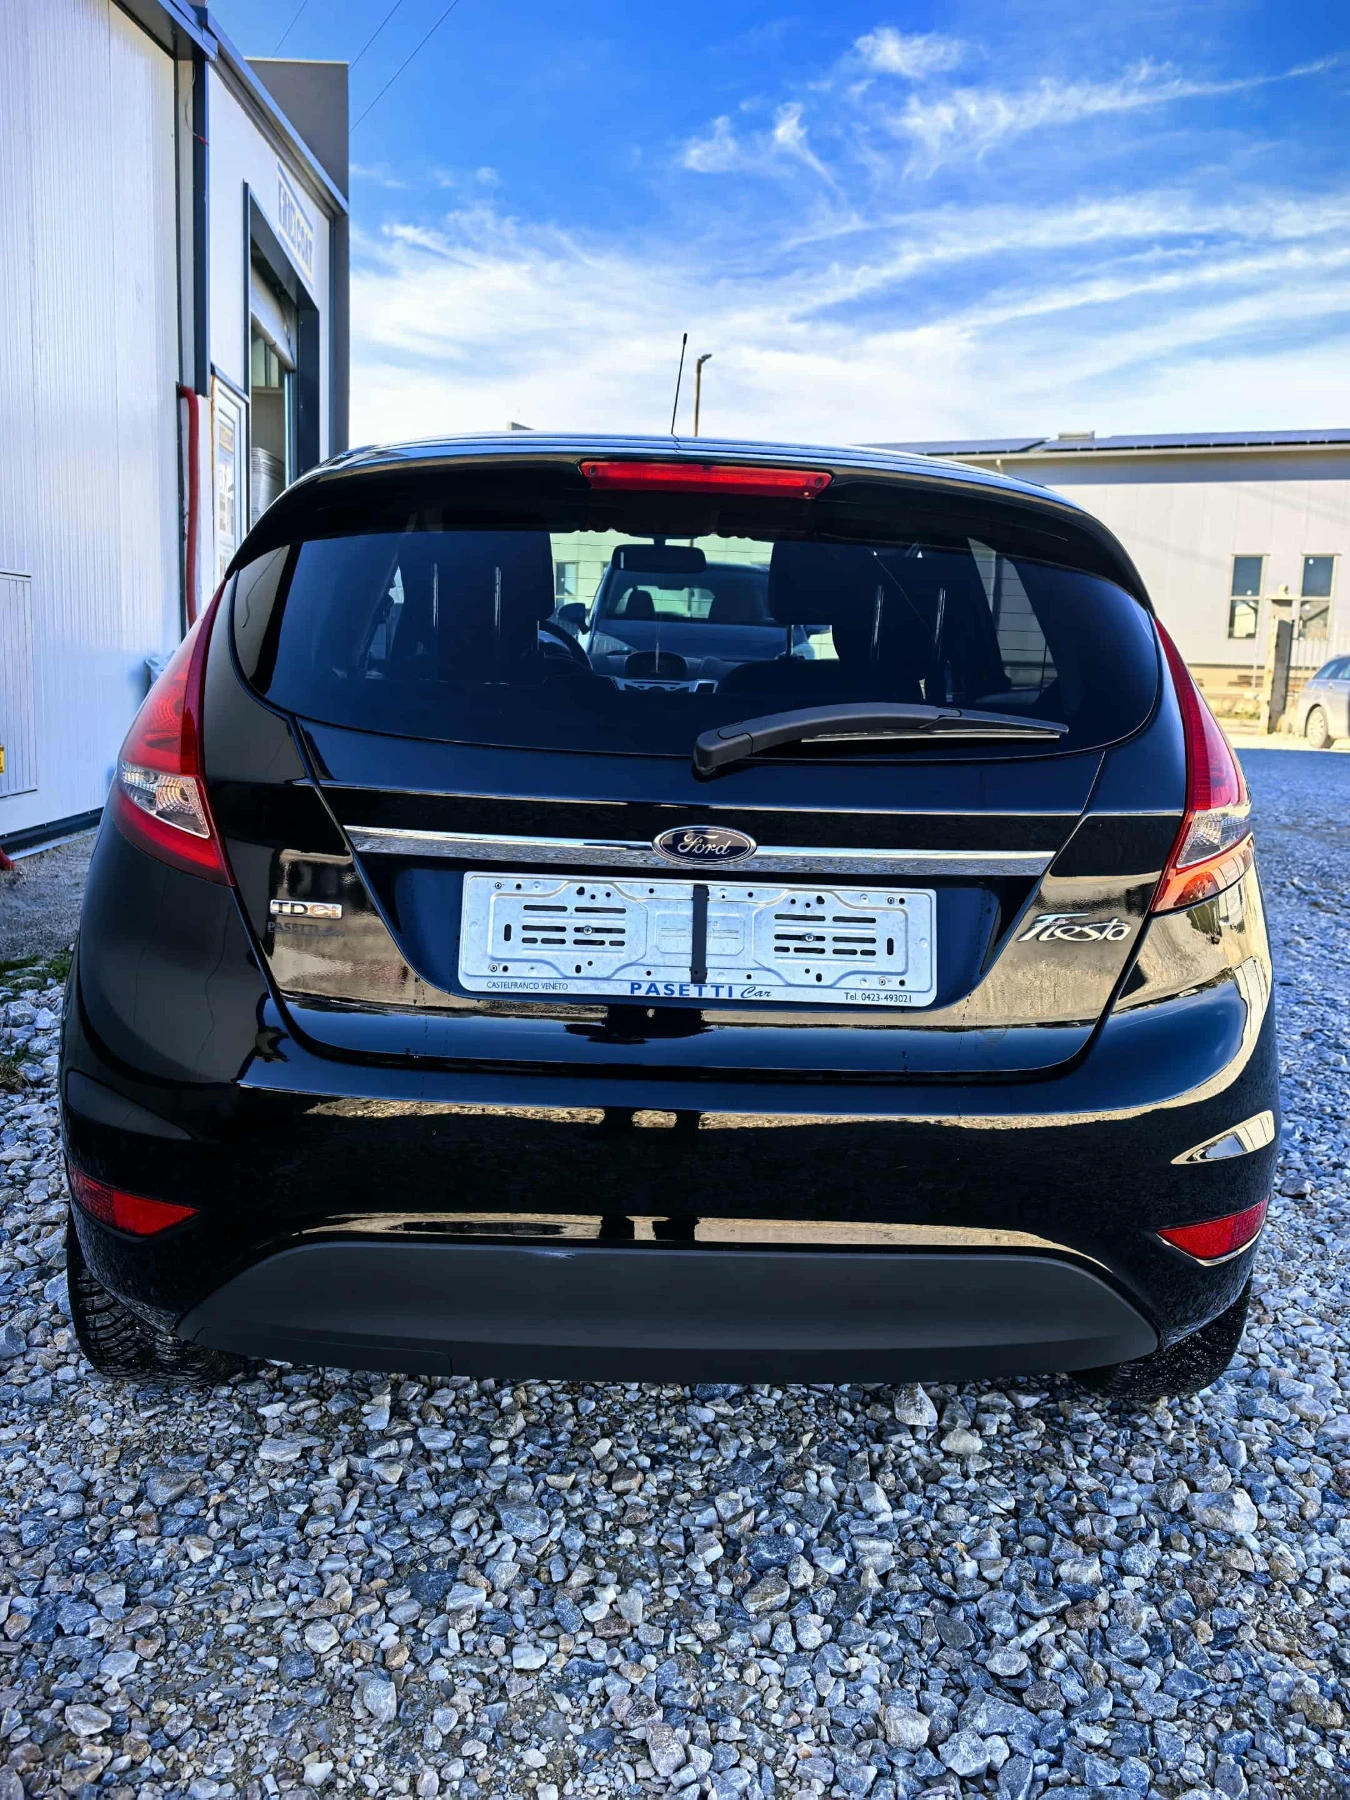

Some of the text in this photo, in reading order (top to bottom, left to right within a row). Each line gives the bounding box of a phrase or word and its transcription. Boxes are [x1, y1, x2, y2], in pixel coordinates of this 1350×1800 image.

[677, 833, 731, 855] Ford
[272, 901, 338, 918] TDCi
[1017, 912, 1132, 942] Fiesta
[487, 981, 568, 990] CASTELFRANCO VENETO
[630, 982, 772, 999] PASETTI Car
[844, 992, 912, 1003] Tel. 0423-493021
